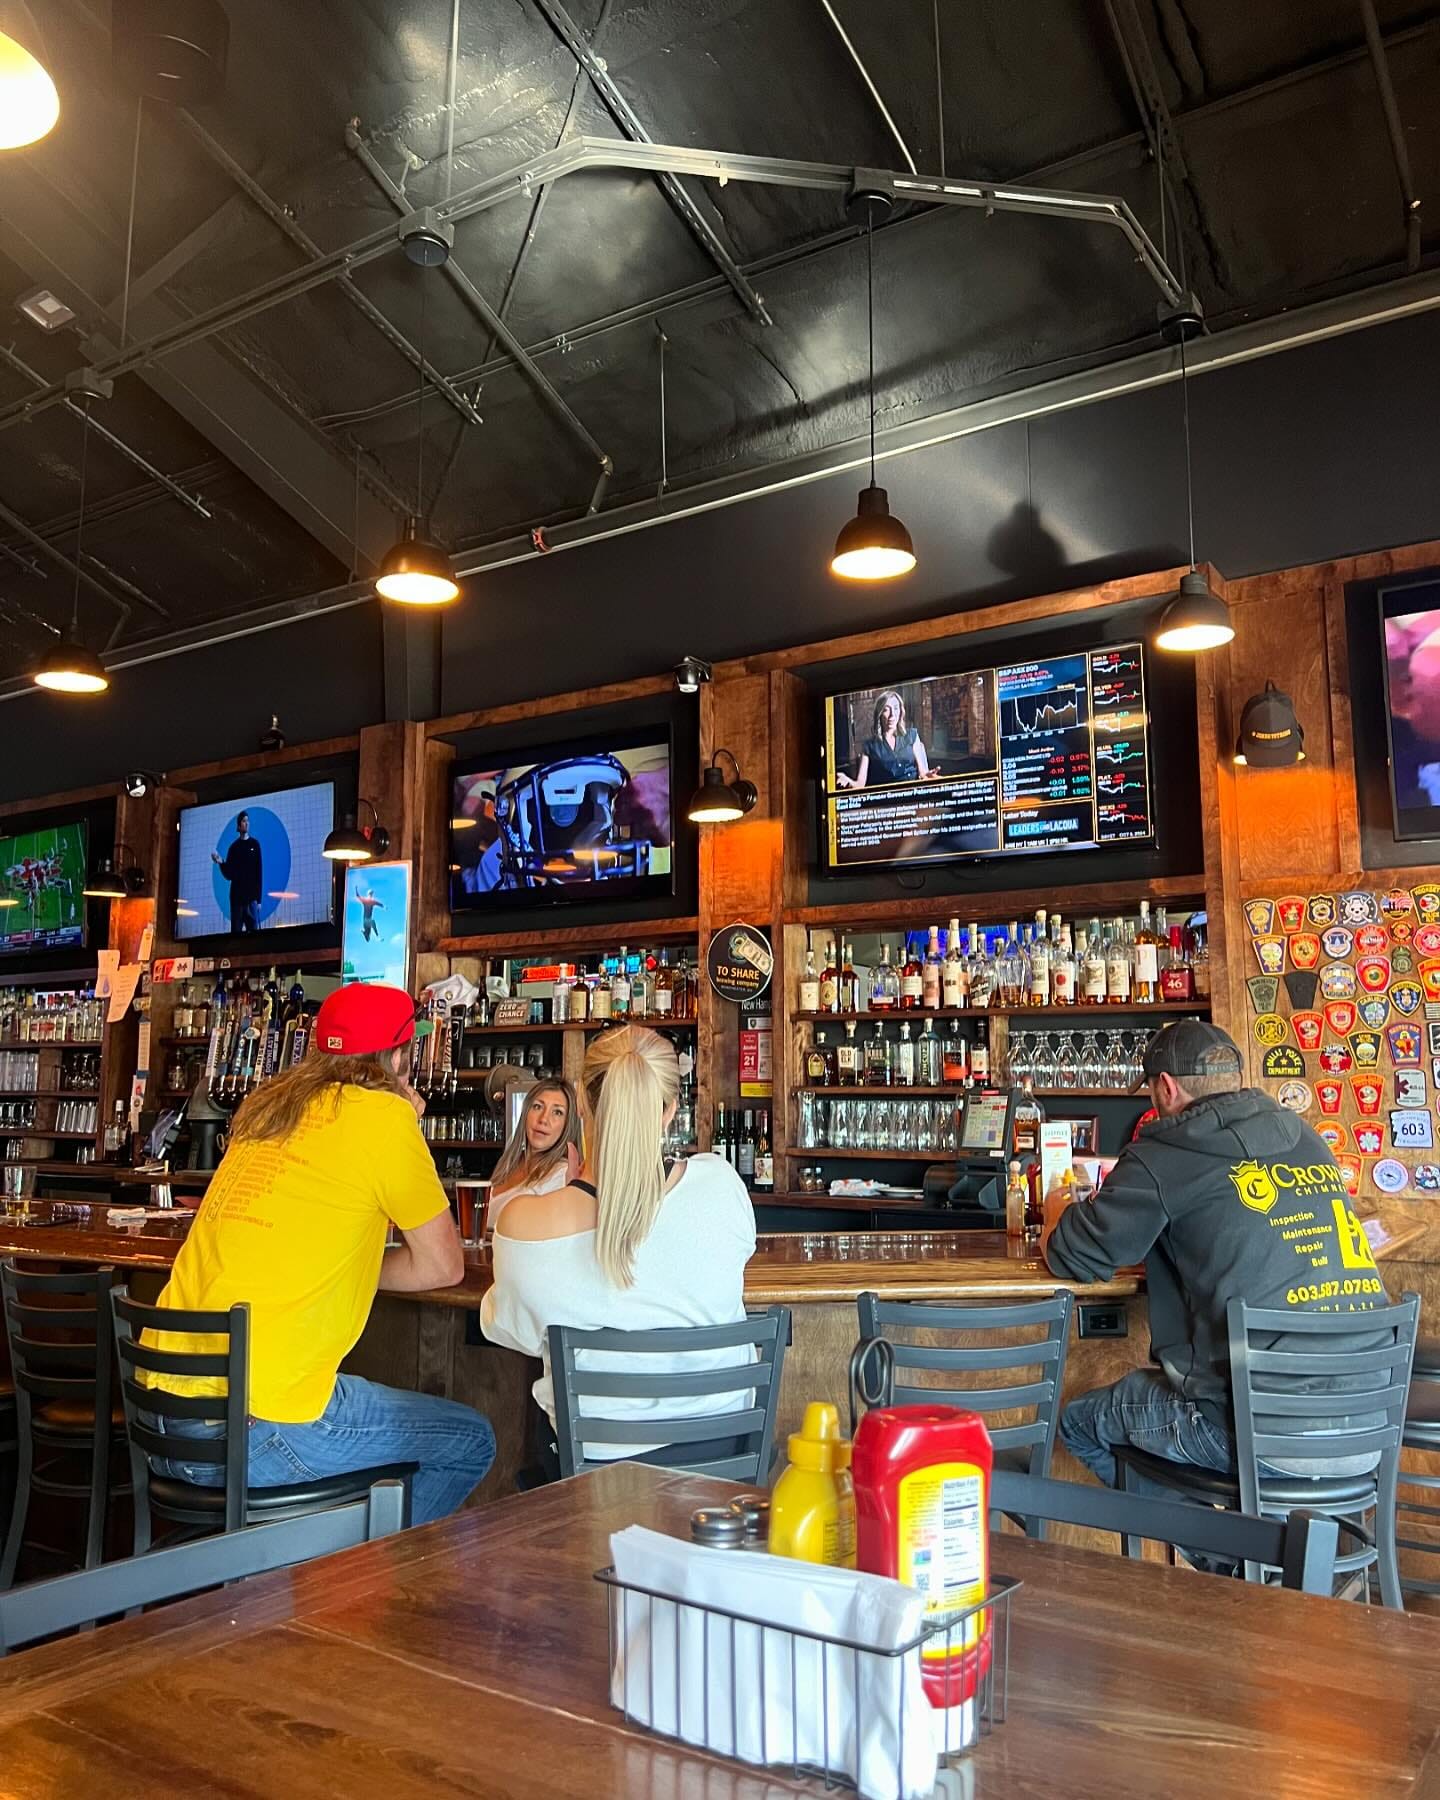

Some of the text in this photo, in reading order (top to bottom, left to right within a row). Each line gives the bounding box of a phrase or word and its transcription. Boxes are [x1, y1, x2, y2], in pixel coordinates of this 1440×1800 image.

[717, 965, 760, 980] TO SHARE
[1167, 979, 1183, 989] 46
[742, 999, 755, 1011] New
[498, 1010, 524, 1018] CHANCE
[744, 1055, 755, 1066] 21
[1266, 1048, 1283, 1067] DALLAS
[1268, 1067, 1301, 1075] DEPARTMENT
[1401, 1122, 1425, 1136] 603
[1269, 1212, 1315, 1227] Inspection
[1282, 1225, 1333, 1240] Maintenance
[1294, 1240, 1324, 1255] Repair
